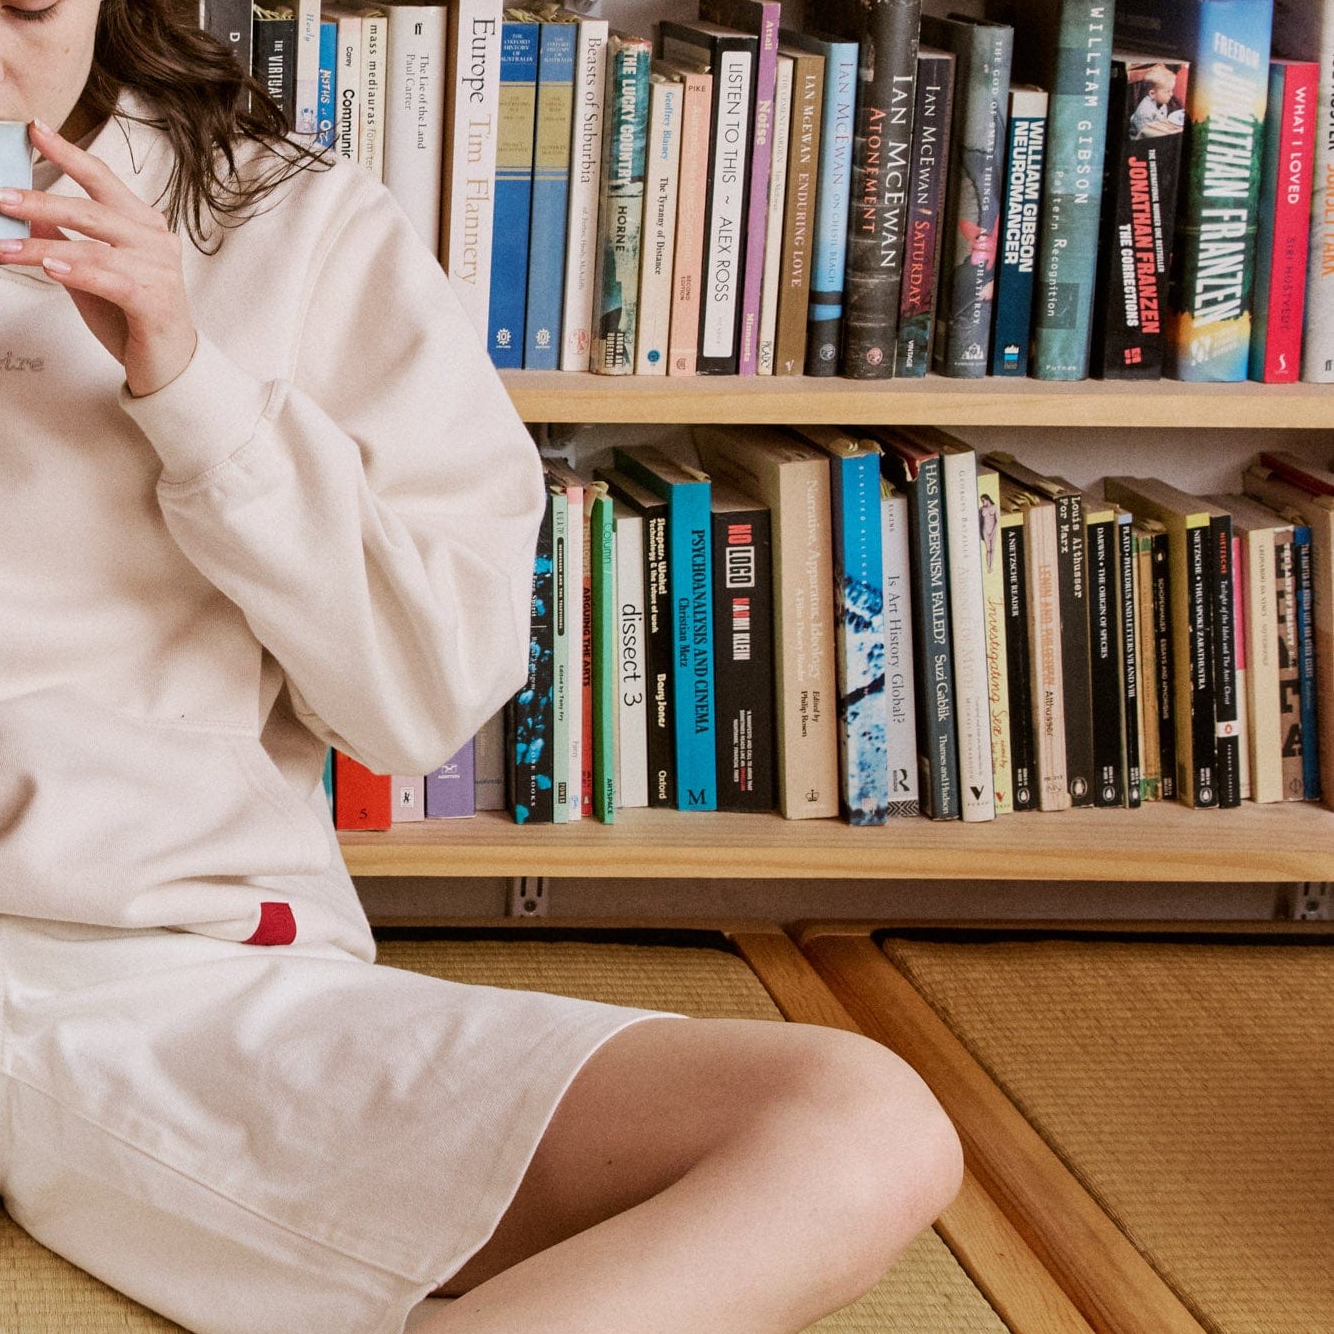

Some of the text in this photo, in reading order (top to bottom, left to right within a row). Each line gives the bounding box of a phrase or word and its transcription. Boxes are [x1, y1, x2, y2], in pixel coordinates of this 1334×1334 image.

[455, 17, 497, 285] Europe Tim Flannery
[580, 37, 602, 183] Beasts of Suburbia
[614, 50, 637, 252] THE LUCKY COUNTRY HORNE
[1074, 7, 1105, 205] WILLIAM GIBSON
[1292, 87, 1307, 135] WHAT
[714, 63, 743, 303] LISTEN TO THIS ALEX ROSS
[1004, 120, 1029, 265] NEUROMANCER
[1019, 121, 1045, 273] WILLIAM GIBSON
[1128, 156, 1160, 334] JONATHAN FRANZEN
[1192, 62, 1256, 328] JONATHAN FRANZEN
[1287, 153, 1302, 205] LOVED
[1118, 224, 1139, 327] THE CORRECTIONS
[727, 524, 752, 660] NO LOGO NAOMI KLEIN
[924, 465, 950, 721] HAS MODERNISM FAILED? Suzi Gablik
[1060, 498, 1069, 553] For Marx
[1071, 497, 1083, 598] Louis Althusser
[1097, 527, 1109, 658] DARWIN THE ORIGIN OF SPECIES
[621, 604, 642, 707] dissect 3
[678, 597, 691, 667] Christian Metz
[691, 529, 710, 734] PSYCHOANALYSIS AND CINEMA
[886, 575, 905, 724] Is Art History Global?
[657, 770, 667, 799] Oxford
